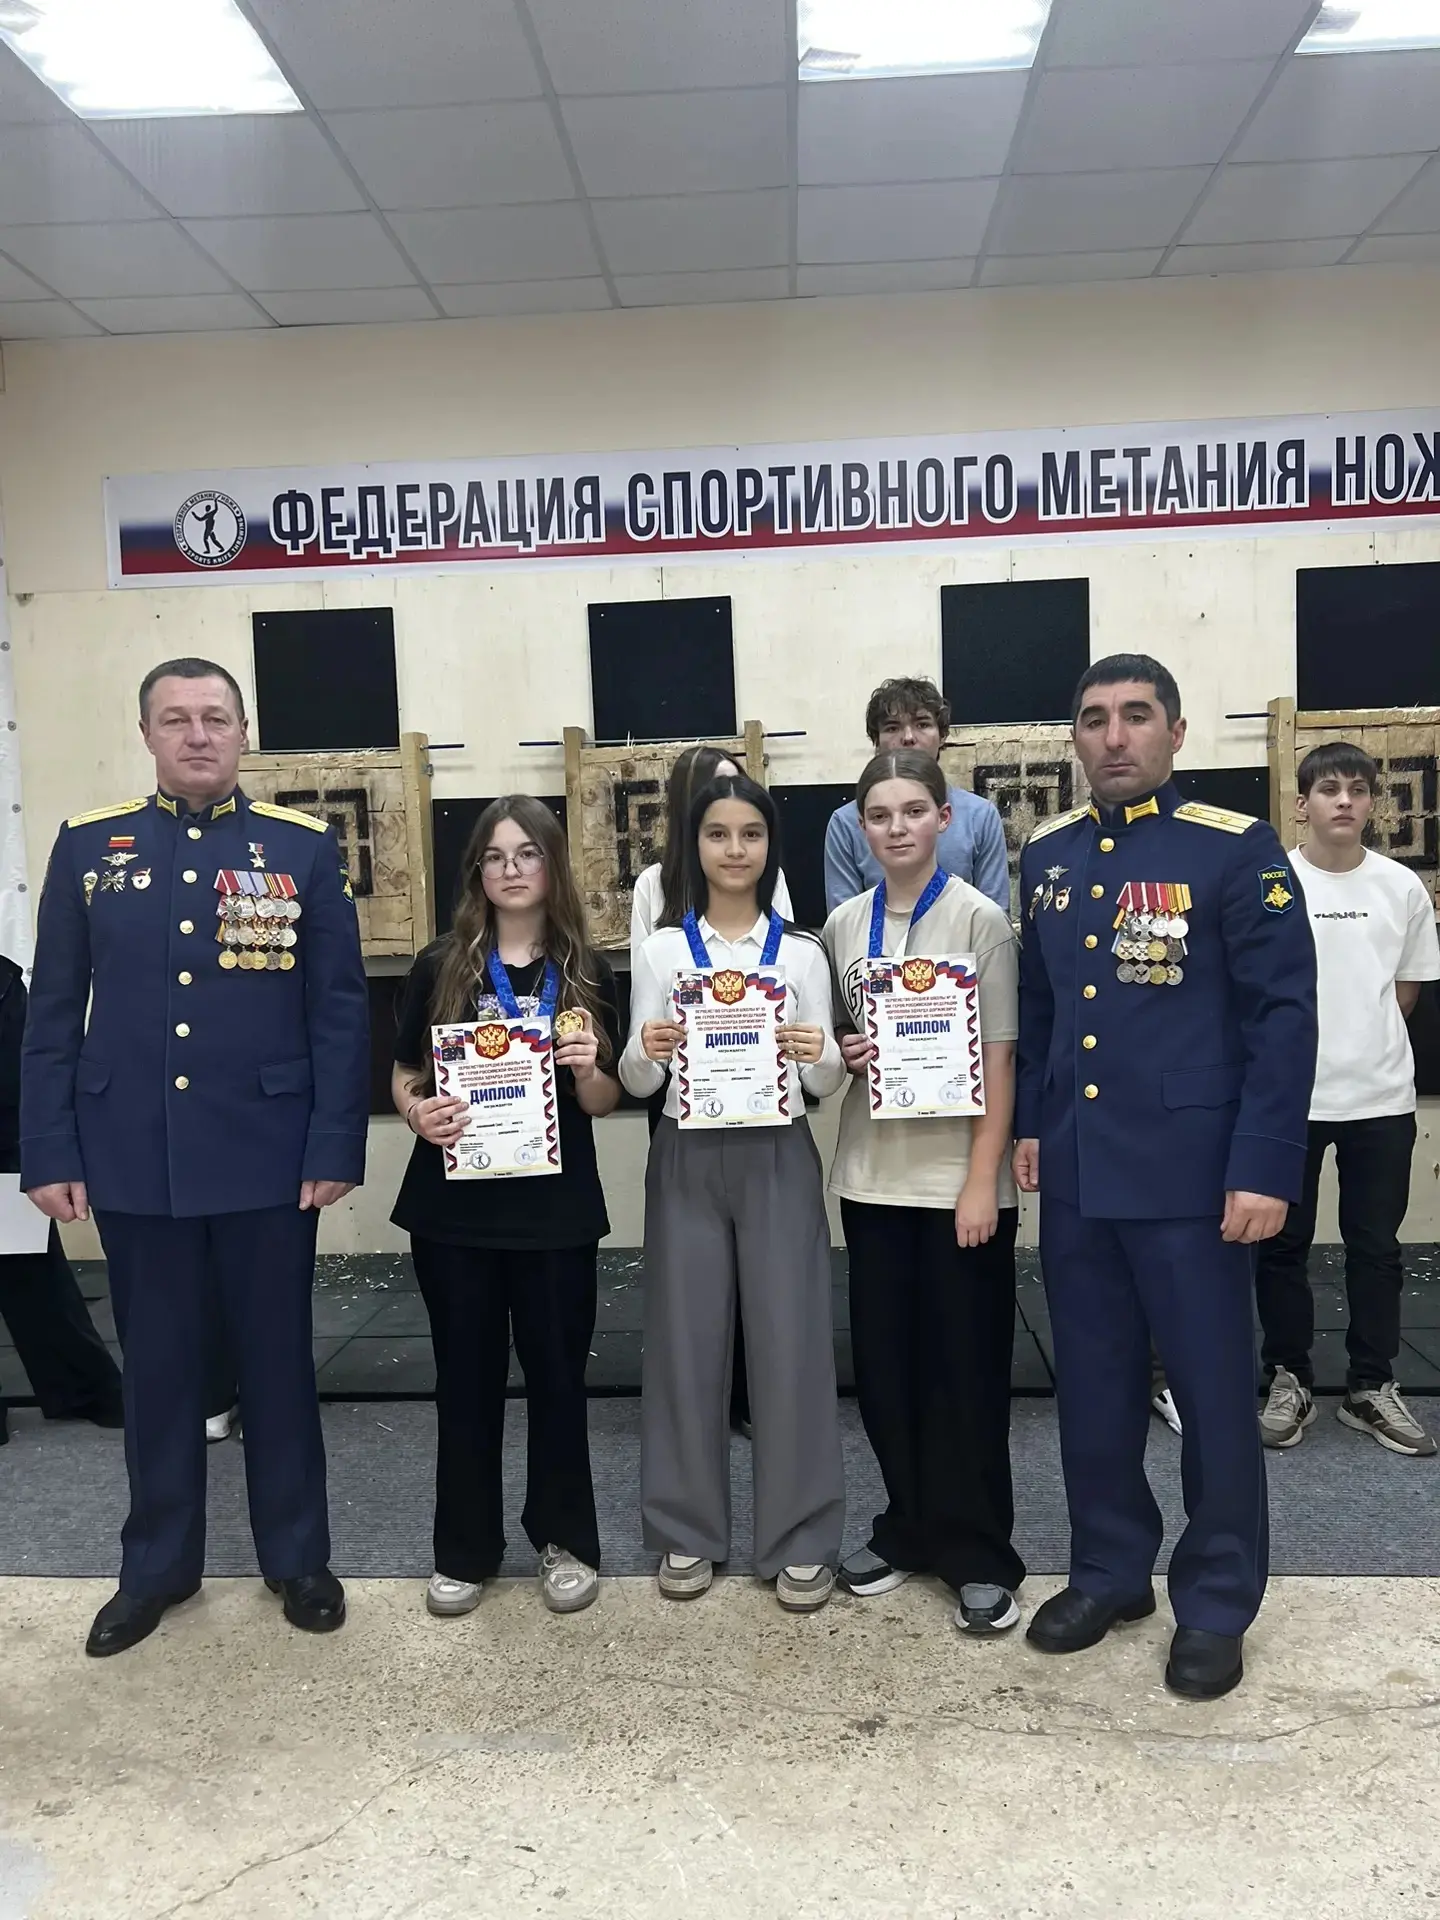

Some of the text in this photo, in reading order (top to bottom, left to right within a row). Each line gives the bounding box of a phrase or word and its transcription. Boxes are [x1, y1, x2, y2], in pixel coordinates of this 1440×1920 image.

[189, 493, 216, 504] МЕТАНИЕ
[271, 475, 604, 555] ФЕДЕРАЦИЯ
[627, 453, 1017, 539] СПОРТИВНОГО
[1040, 438, 1307, 517] МЕТАНИЯ
[187, 550, 211, 564] SPORTS
[213, 552, 233, 564] KNIFE
[896, 1020, 950, 1037] ДИПЛОМ
[706, 1032, 759, 1048] ДИПЛОМ
[470, 1086, 525, 1105] ДИПЛОМ
